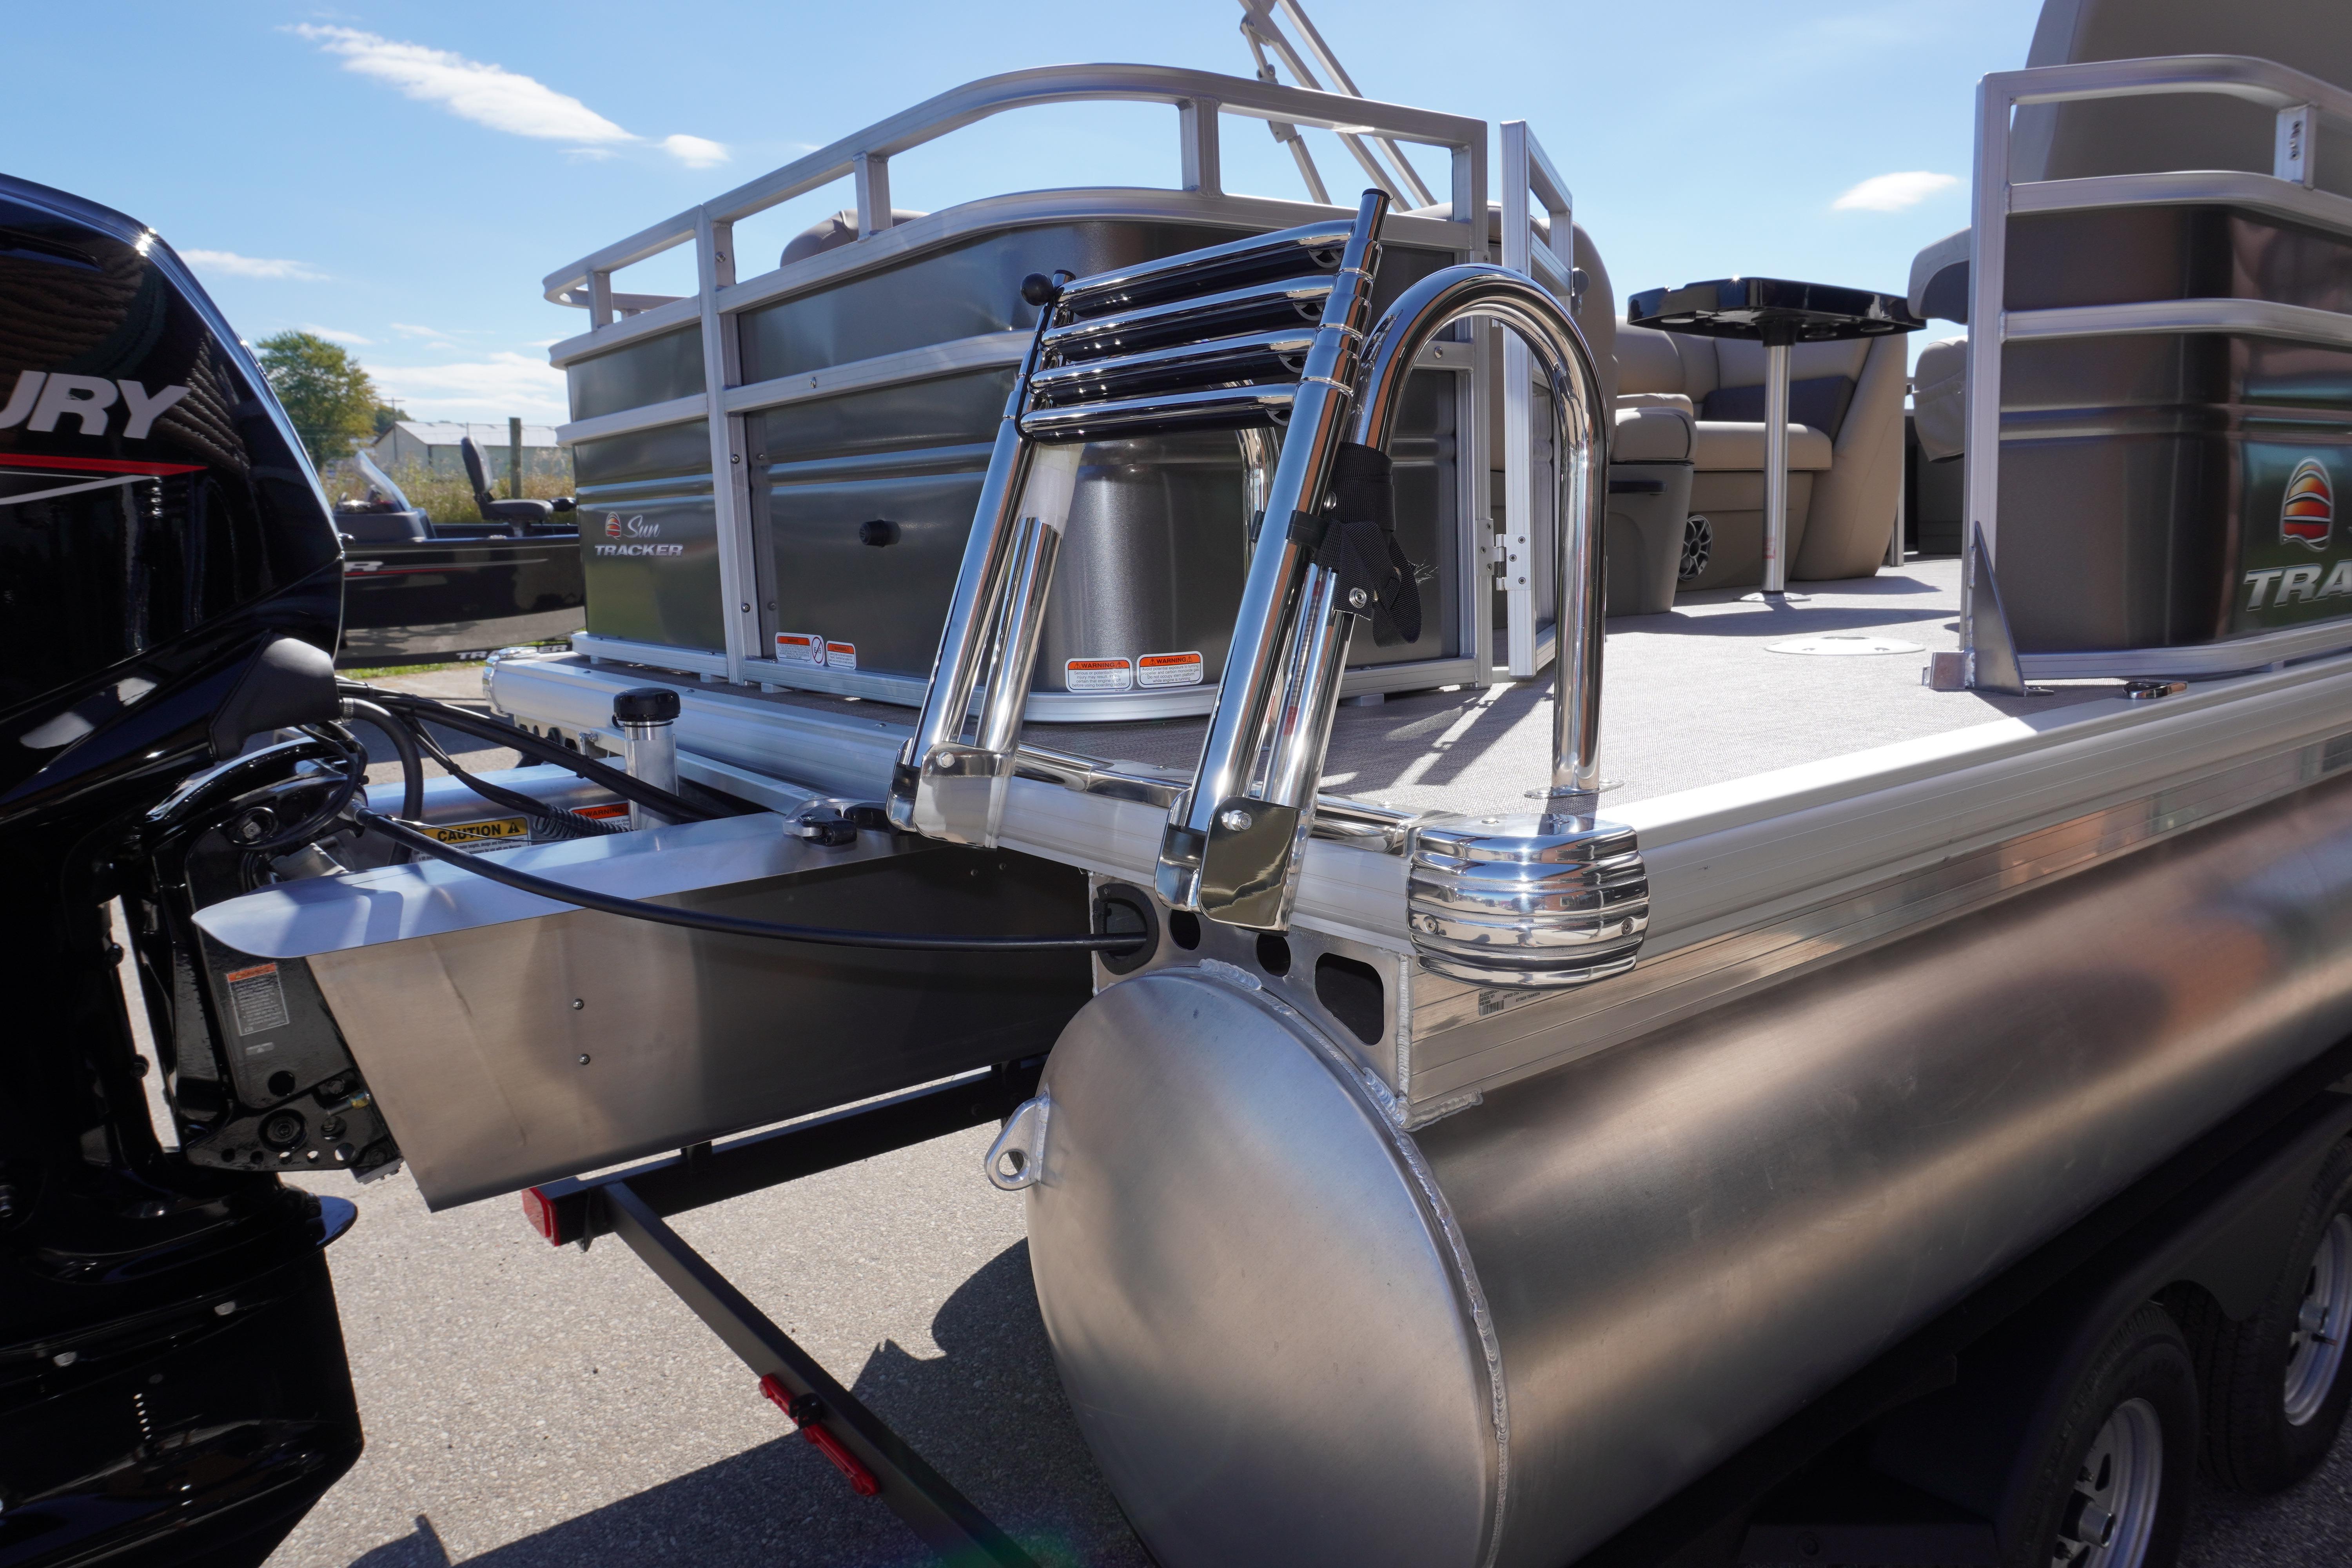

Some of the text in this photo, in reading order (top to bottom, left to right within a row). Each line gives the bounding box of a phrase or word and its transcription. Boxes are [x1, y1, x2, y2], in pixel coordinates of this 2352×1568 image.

[623, 514, 660, 538] Sun
[595, 544, 683, 556] TRACKER
[585, 807, 624, 817] WARNING
[437, 824, 501, 842] CAUTION
